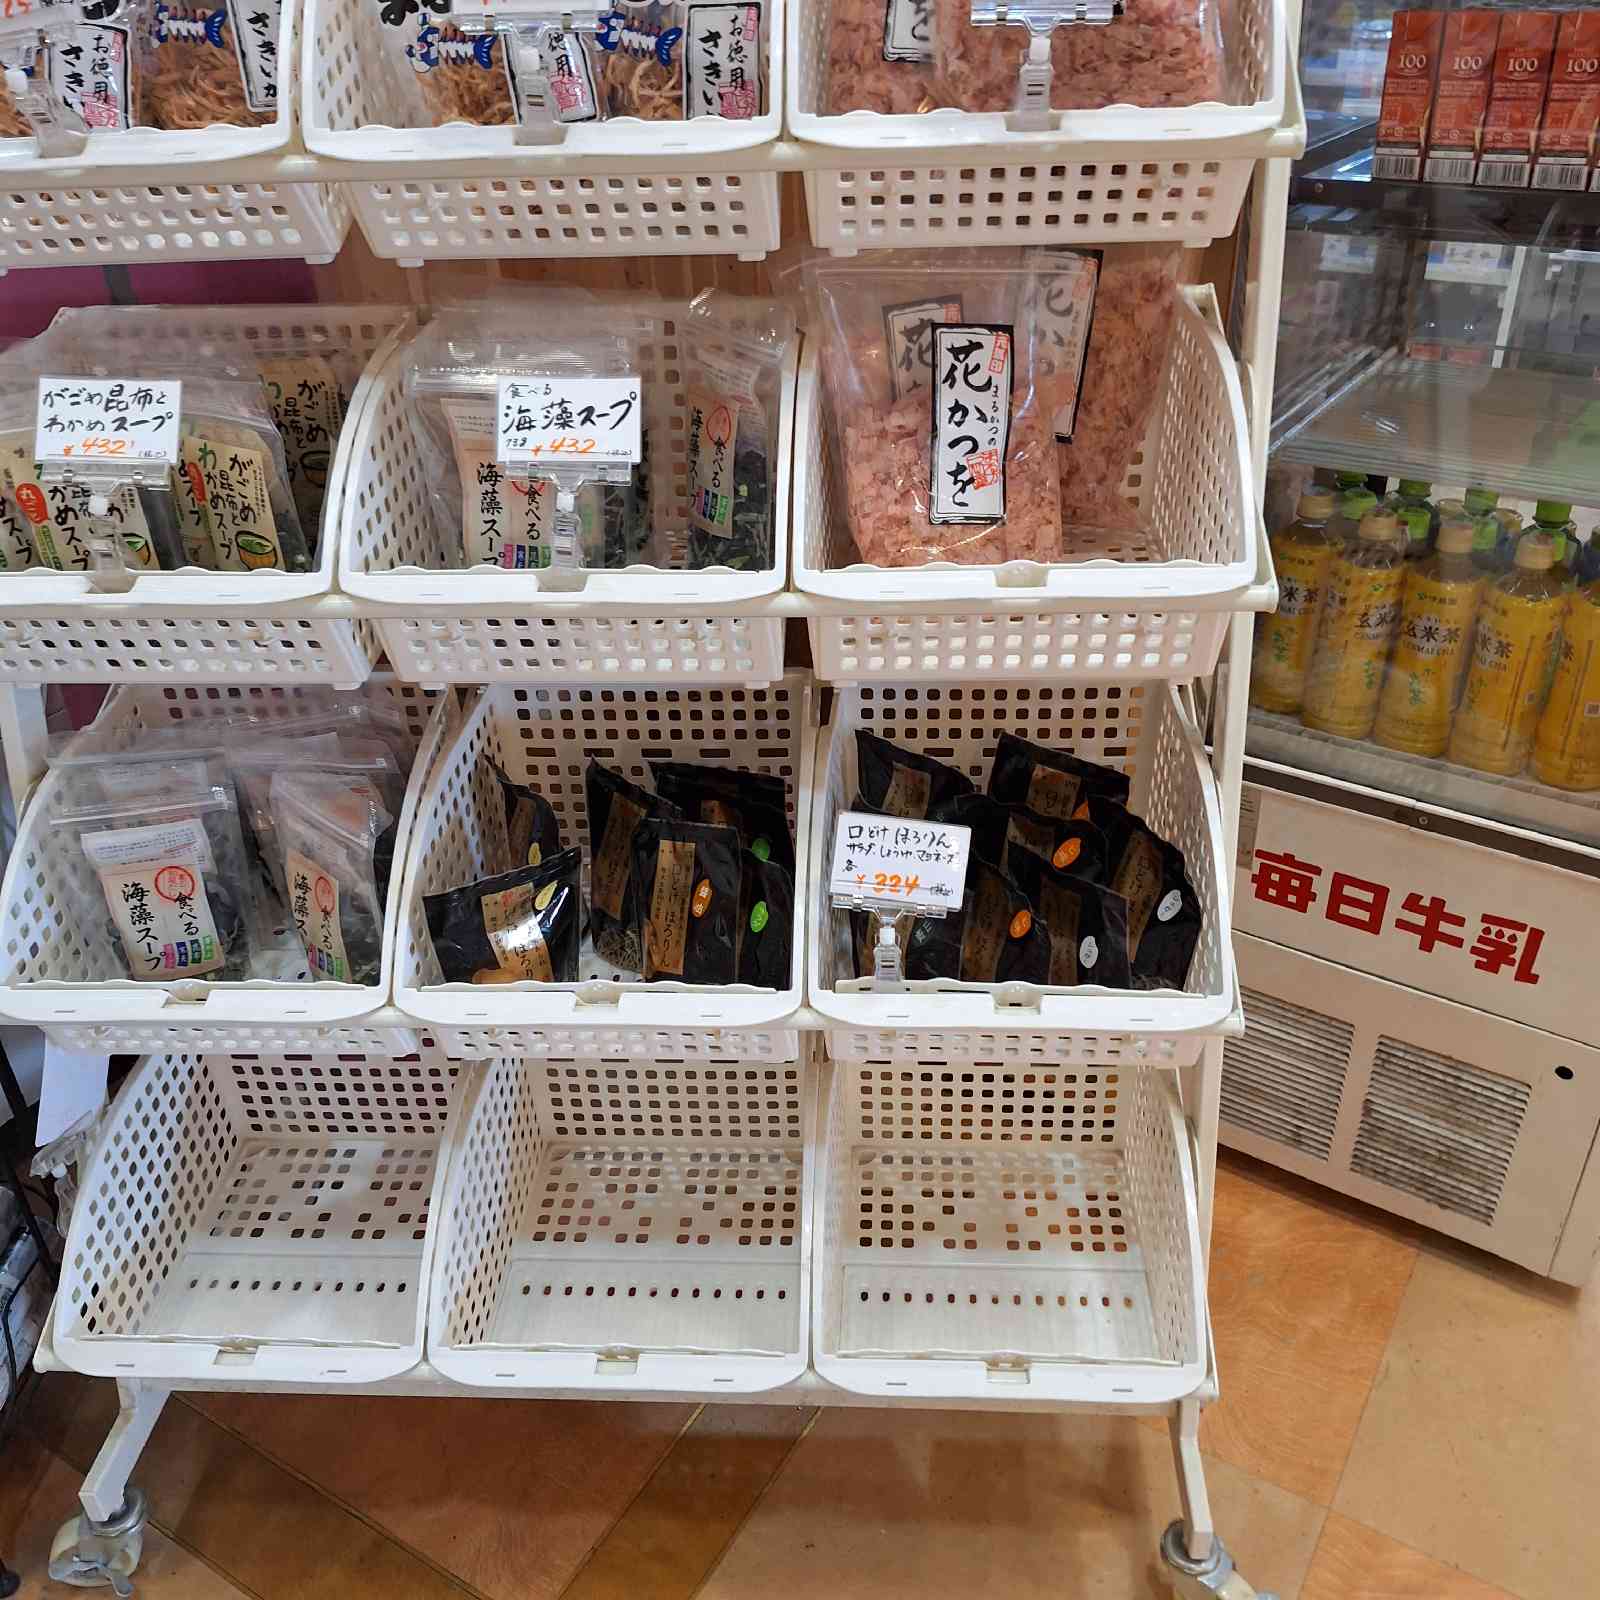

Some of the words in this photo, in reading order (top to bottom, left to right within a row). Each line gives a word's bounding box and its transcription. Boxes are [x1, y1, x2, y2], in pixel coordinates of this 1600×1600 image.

[699, 28, 722, 116] さきい
[727, 14, 748, 92] お徳用
[1400, 54, 1427, 69] 100
[1452, 56, 1483, 71] 100
[1507, 57, 1538, 72] 100
[1566, 58, 1599, 74] 100
[60, 44, 92, 128] さきい
[501, 391, 638, 435] 海藻スープ
[505, 382, 553, 399] 食べる
[43, 411, 174, 433] わかめスープ
[942, 339, 992, 508] 花かつを
[198, 441, 232, 560] わかめスープ
[229, 453, 257, 524] がごめ
[524, 485, 543, 542] 食べる
[121, 881, 168, 972] 海藻スープ
[175, 892, 200, 936] 食べる
[1251, 848, 1545, 985] 毎日牛乳
